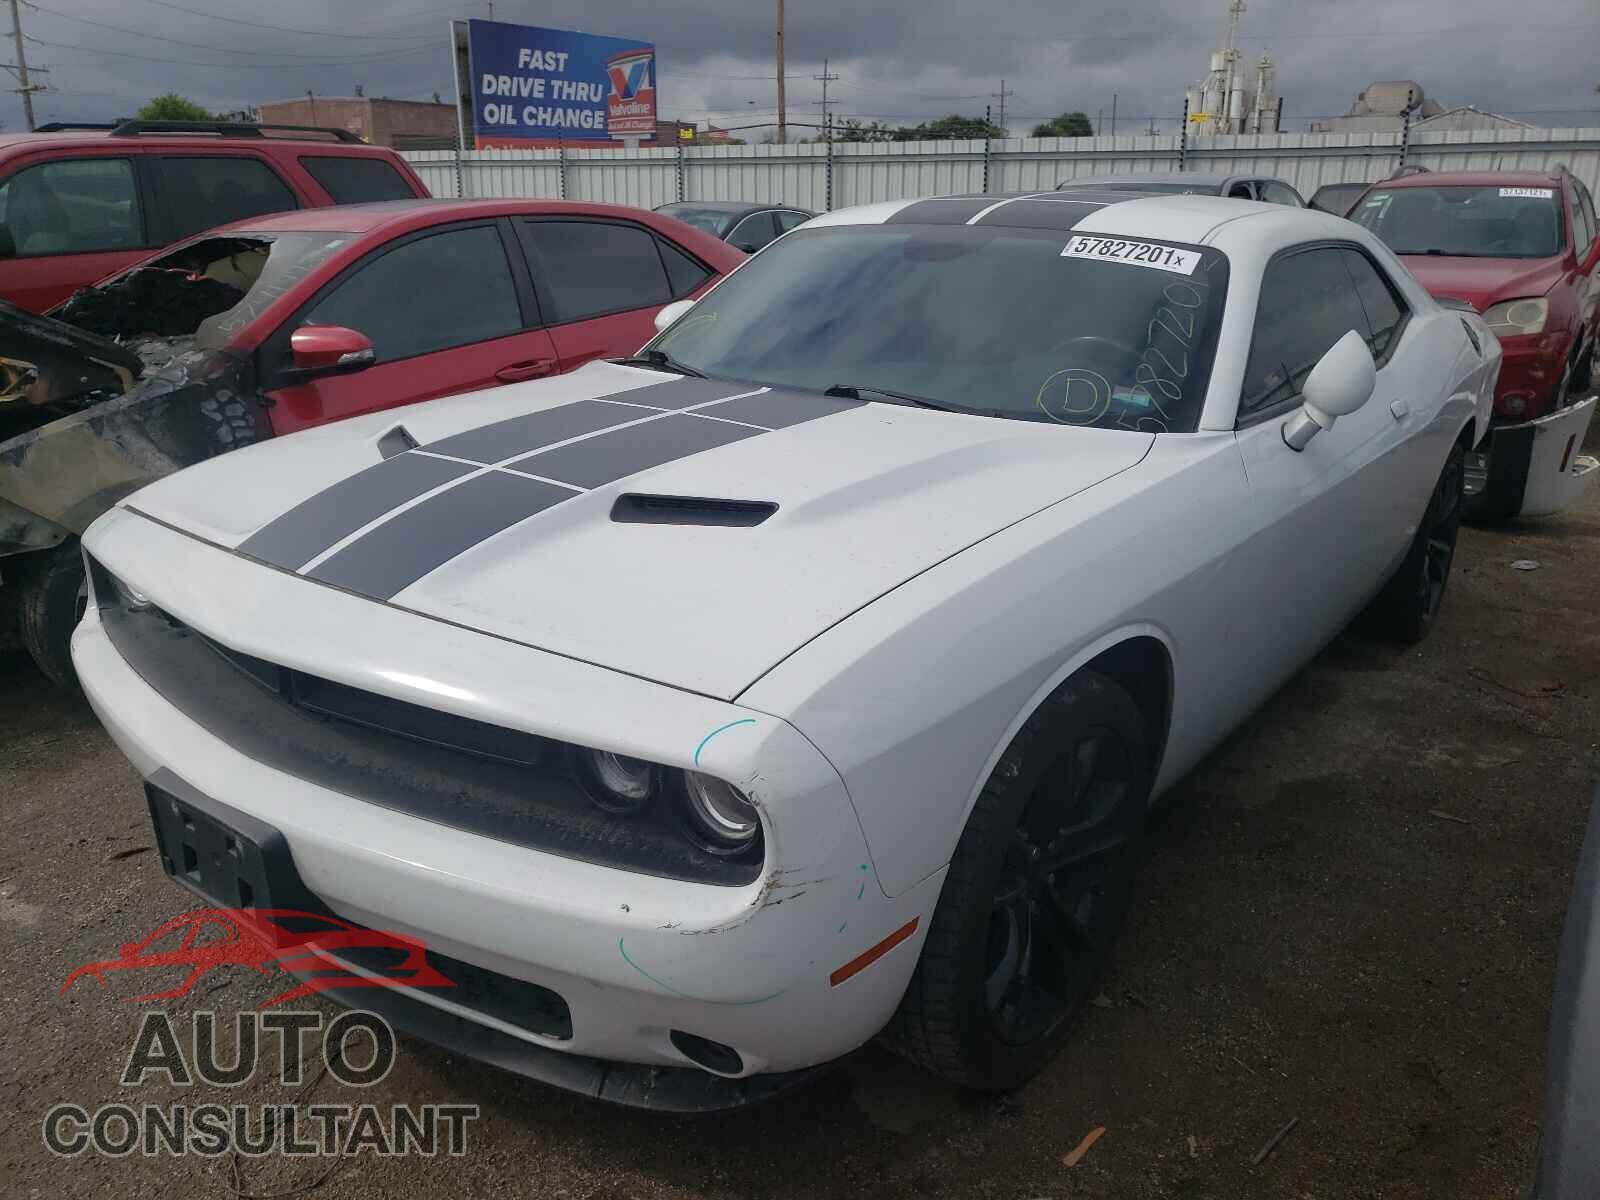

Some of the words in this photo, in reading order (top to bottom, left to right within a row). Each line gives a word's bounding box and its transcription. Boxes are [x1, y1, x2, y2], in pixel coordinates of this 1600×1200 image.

[519, 48, 568, 72] FAST
[482, 74, 545, 98] DRIVE
[551, 78, 603, 103] THRU
[483, 103, 518, 126] OIL
[522, 106, 605, 129] CHANGE
[609, 102, 650, 117] Valvoline
[1063, 376, 1098, 412] D
